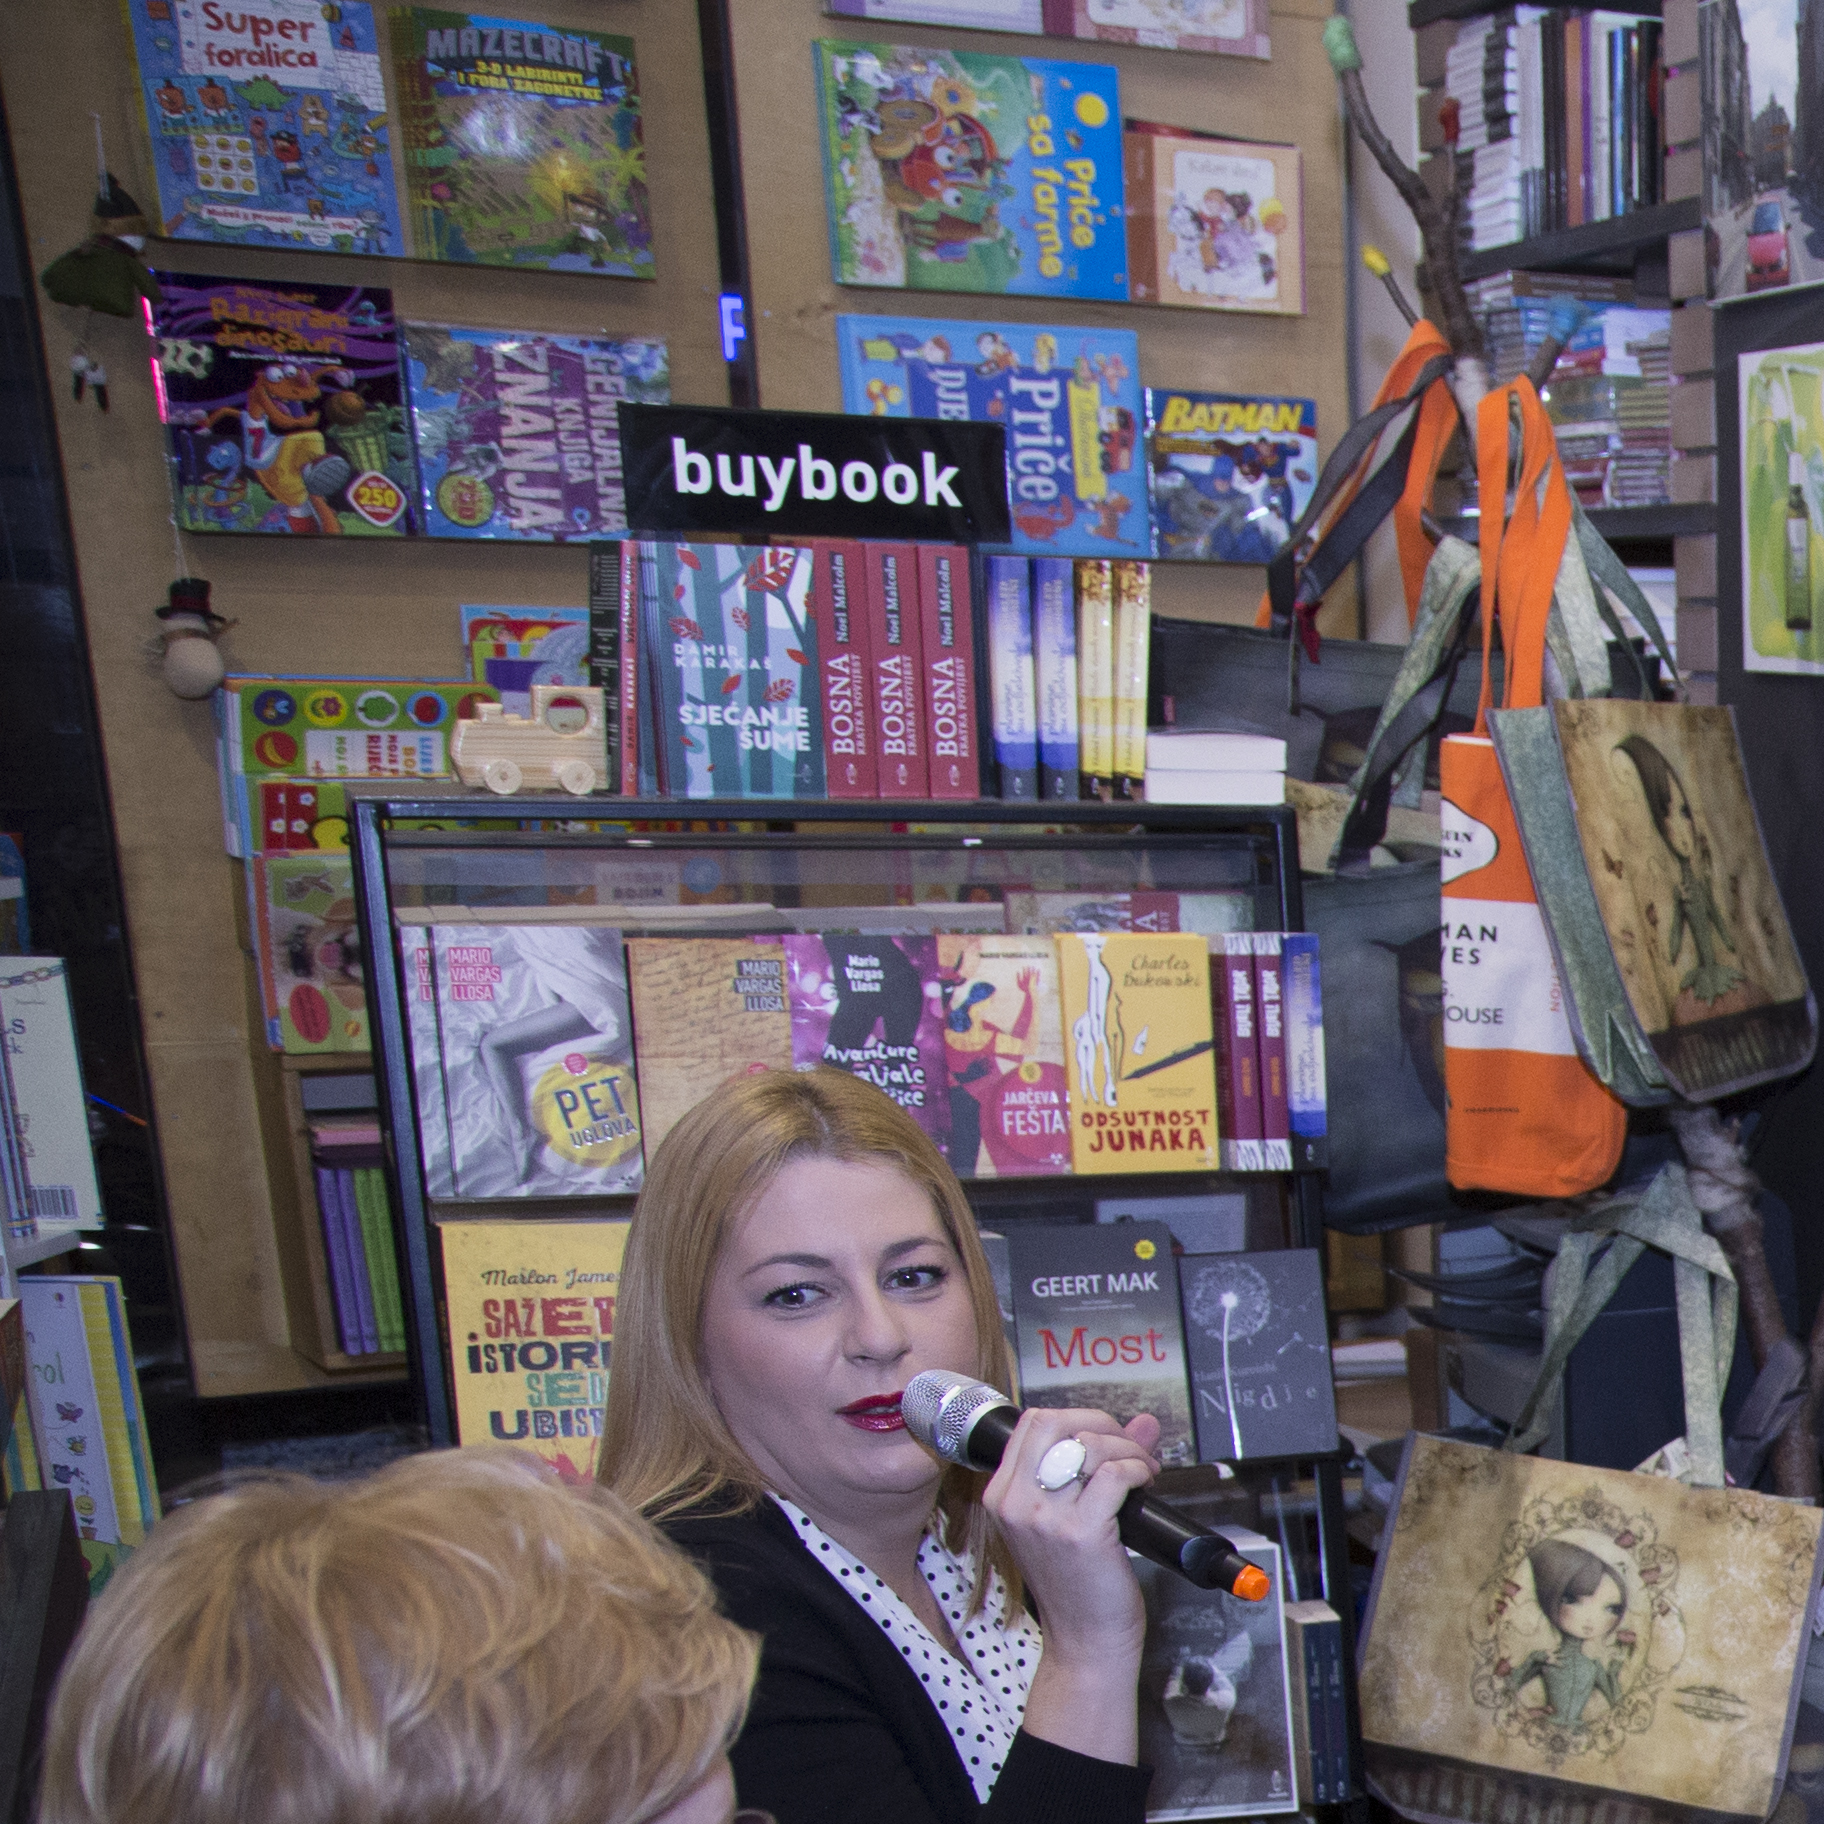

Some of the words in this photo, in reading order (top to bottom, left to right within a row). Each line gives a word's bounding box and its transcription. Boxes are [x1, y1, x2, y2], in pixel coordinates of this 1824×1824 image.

[203, 2, 316, 47] Super
[205, 42, 318, 67] foralica
[427, 28, 626, 83] MAZECRAFT
[1027, 112, 1056, 155] sa
[1032, 167, 1064, 278] farme
[1158, 395, 1303, 434] BATMAN
[493, 343, 565, 530] ZNANJA
[553, 397, 594, 484] KNJIGA
[581, 353, 629, 533] GENIJALNA
[1009, 375, 1073, 501] Priče
[672, 437, 964, 512] buybook
[358, 486, 398, 508] 250
[832, 553, 847, 609] Malcolm
[884, 556, 898, 611] Malcolm
[937, 558, 951, 613] Malcolm
[835, 611, 849, 643] Noel
[887, 613, 901, 645] Noel
[940, 616, 953, 647] Noel
[673, 643, 741, 660] DAMIR
[675, 655, 772, 672] KARAKAŠ
[679, 700, 812, 728] SJEĆANJE
[827, 652, 855, 755] BOSNA
[878, 654, 906, 756] BOSNA
[931, 656, 959, 757] BOSNA
[739, 722, 814, 753] ŠUME
[450, 948, 492, 965] MARIO
[741, 961, 783, 977] MARIO
[451, 966, 502, 983] VARGAS
[735, 979, 783, 995] VARGAS
[453, 985, 495, 1001] LLOSA
[746, 996, 785, 1012] LLOSA
[822, 1041, 920, 1063] Avanture
[553, 1075, 625, 1130] PET
[1001, 1087, 1060, 1107] JARČEVA
[569, 1116, 638, 1149] UGLOVA
[1001, 1104, 1067, 1136] FEŠTA
[1081, 1109, 1210, 1128] ODSUTNOST
[1089, 1127, 1207, 1152] JUNAKA
[481, 1267, 559, 1287] Marlon
[564, 1267, 620, 1290] Jame
[1031, 1274, 1102, 1298] GEERT
[1107, 1271, 1160, 1294] MAK
[483, 1296, 617, 1339] SAŽET
[1036, 1326, 1166, 1370] Most
[489, 1407, 608, 1440] UBIST
